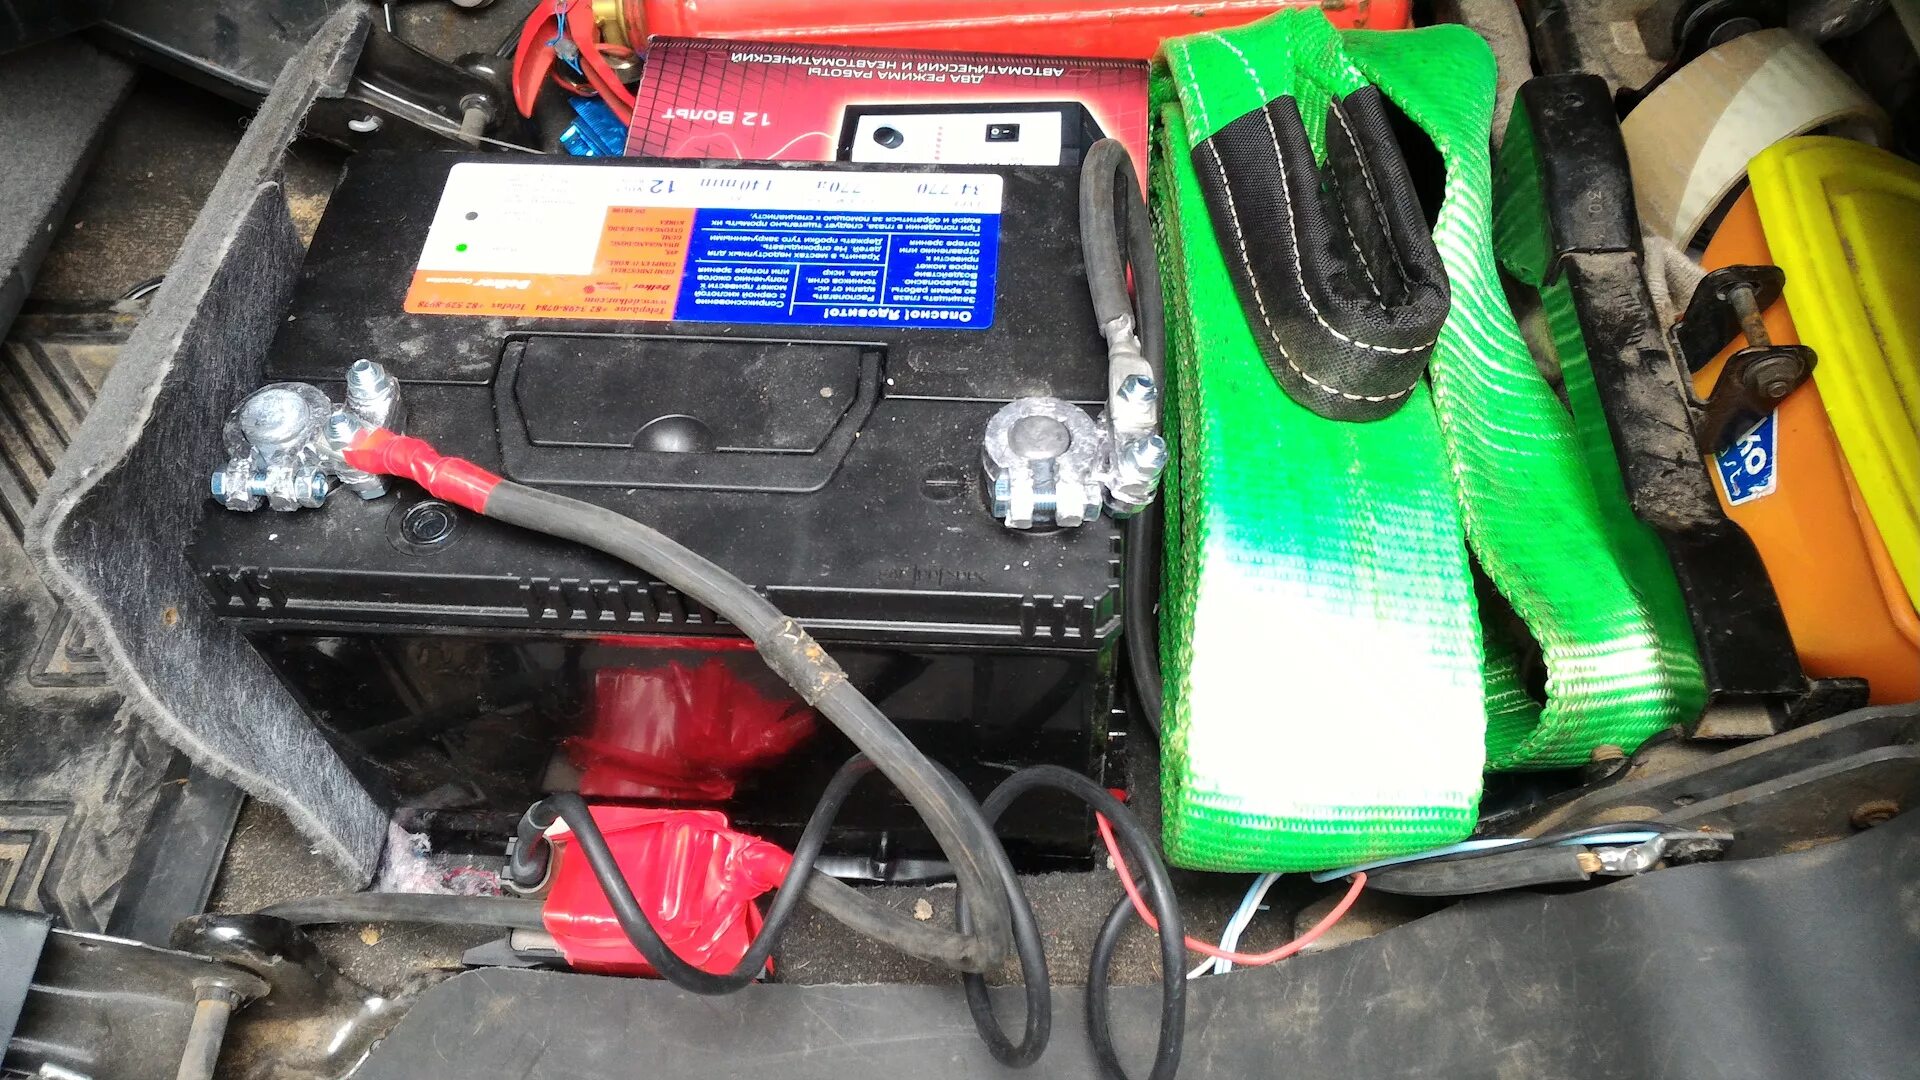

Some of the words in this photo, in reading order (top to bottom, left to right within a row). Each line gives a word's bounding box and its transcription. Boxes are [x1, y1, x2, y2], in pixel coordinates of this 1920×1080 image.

[731, 52, 897, 70] НЕАВТОМАТИЧЕСКИЙ
[902, 61, 912, 71] И
[916, 62, 1064, 78] АВТОМАТИЧЕСКИЙ
[808, 67, 873, 79] РАБОТЫ
[876, 70, 945, 82] РЕЖИМА
[950, 74, 984, 84] ДВА
[662, 108, 734, 125] Вольт
[744, 112, 771, 127] 12
[650, 180, 675, 193] 12
[823, 214, 870, 222] помощью
[886, 216, 941, 224] обратиться
[952, 216, 981, 224] водой
[770, 220, 821, 228] тщательно
[905, 223, 958, 231] попадании
[961, 224, 980, 232] При
[841, 237, 883, 245] Держать
[729, 250, 791, 258] недоступных
[839, 253, 880, 261] Хранить
[734, 275, 788, 283] получению
[694, 290, 739, 298] кислотой
[813, 293, 874, 302] Располагать
[893, 294, 920, 302] глаза
[695, 298, 784, 308] Соприкосновение
[922, 295, 976, 303] Защищать
[824, 308, 900, 320] Ядовито!
[905, 308, 972, 322] Опасно!
